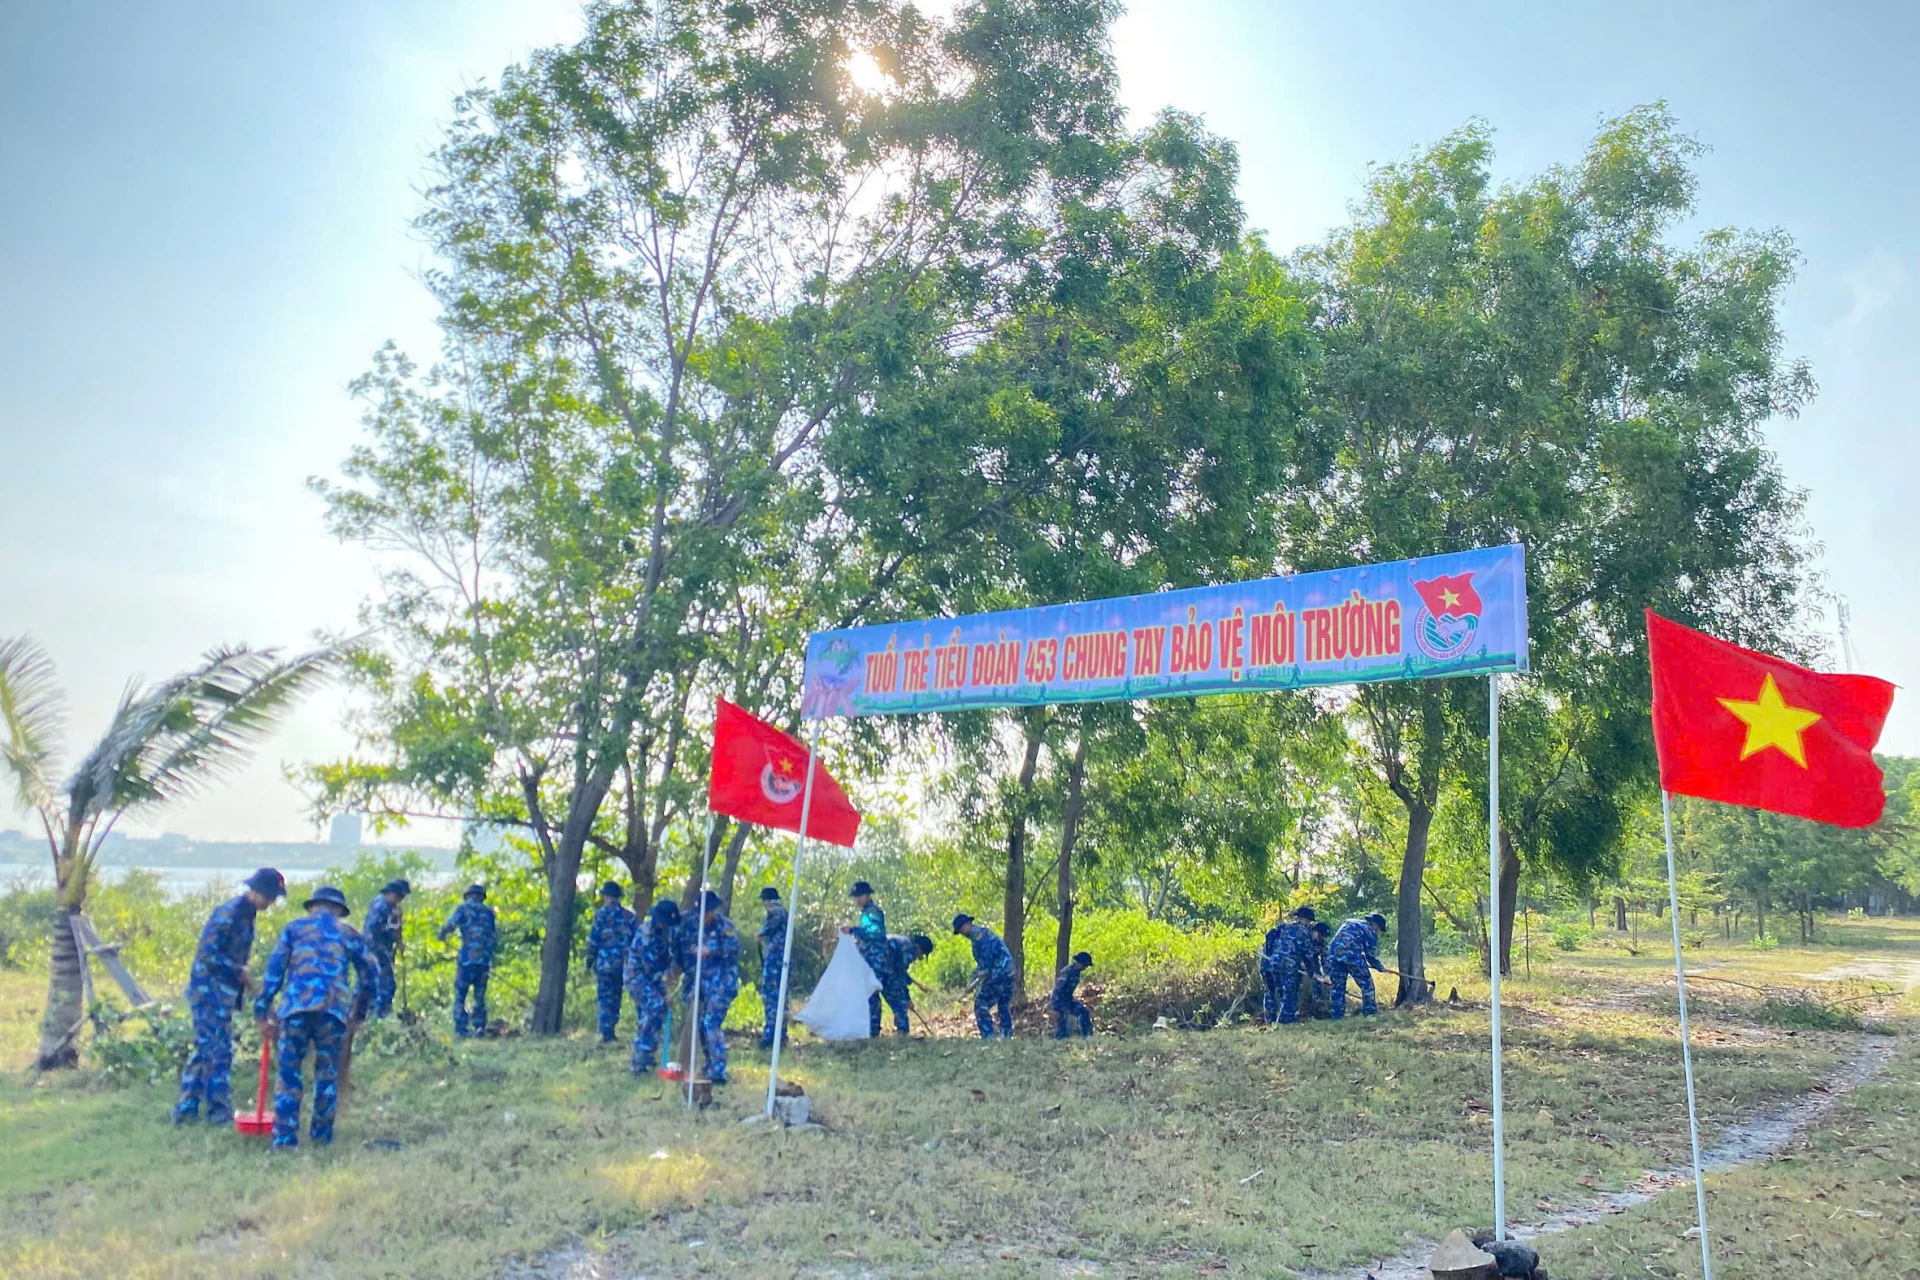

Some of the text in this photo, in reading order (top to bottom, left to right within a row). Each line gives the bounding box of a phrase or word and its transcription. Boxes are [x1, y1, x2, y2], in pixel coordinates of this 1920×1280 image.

[866, 634, 898, 694] TUỔI
[901, 633, 931, 691] TRẺ
[934, 626, 968, 689] TIỂU
[972, 632, 1020, 686] ĐOÀN
[1023, 639, 1059, 682] 453
[1061, 630, 1128, 681] CHUNG
[1132, 626, 1167, 675] TAY
[1170, 605, 1213, 673] BẢO
[1218, 606, 1245, 682] VỆ
[1250, 601, 1296, 666] MÔI
[1301, 589, 1402, 661] TRƯỜNG
